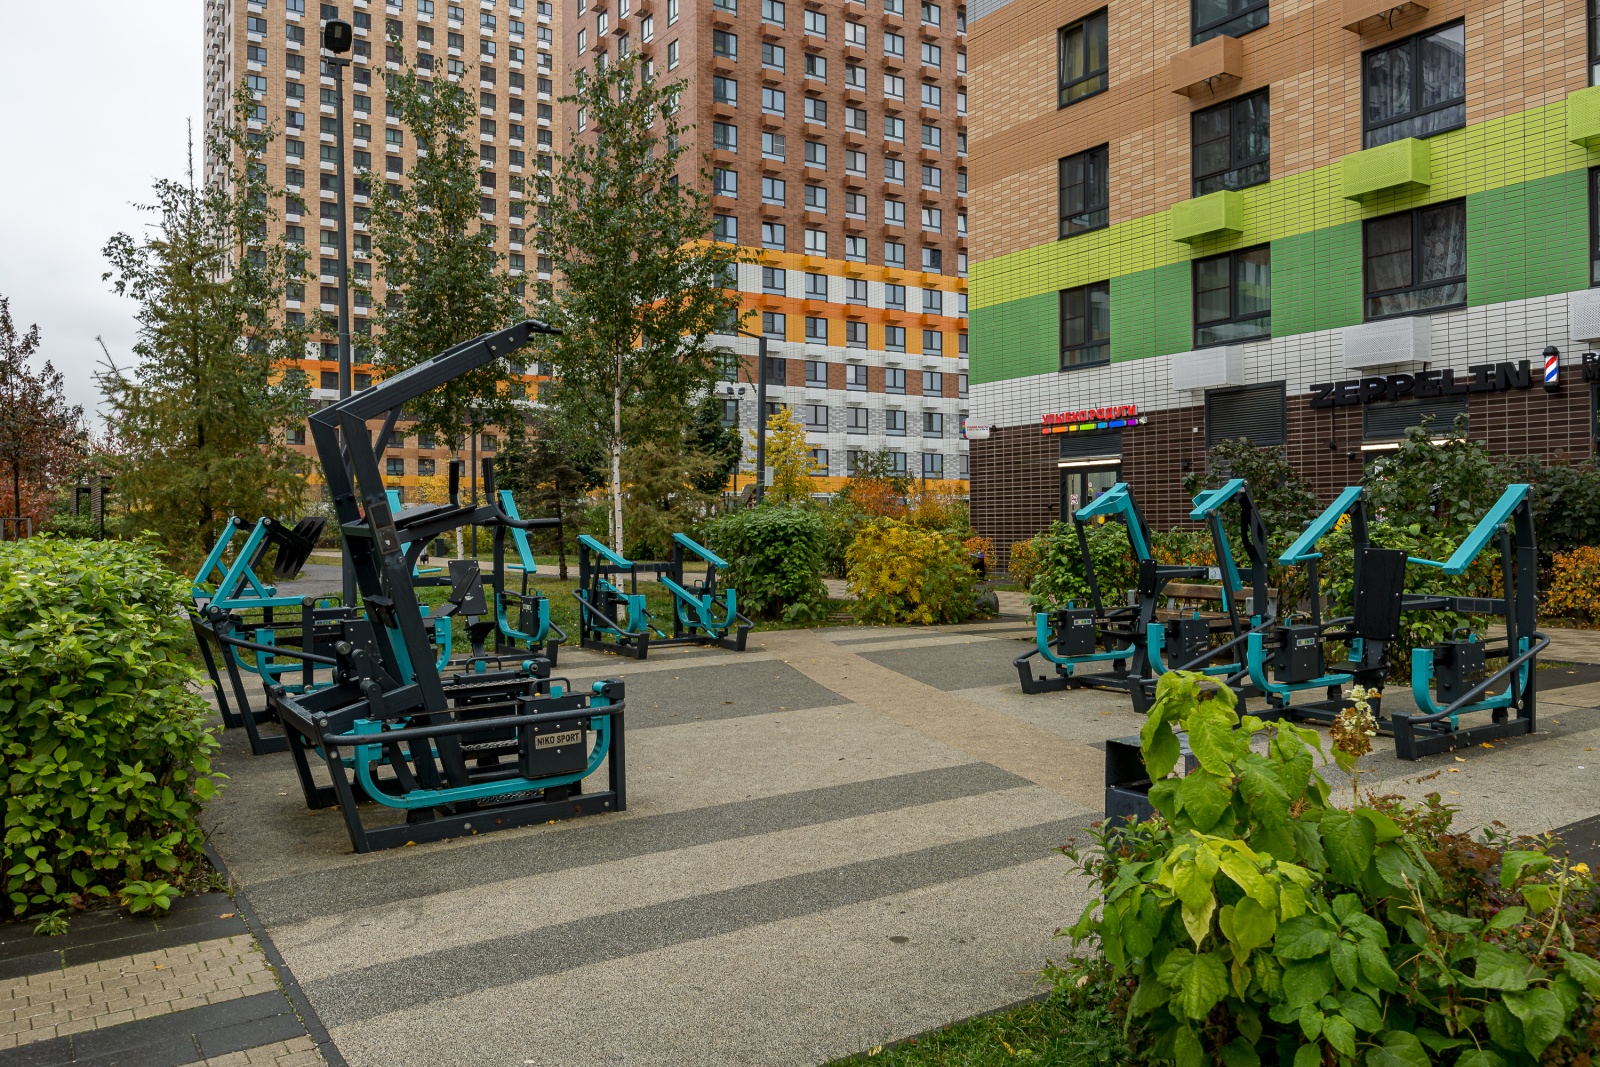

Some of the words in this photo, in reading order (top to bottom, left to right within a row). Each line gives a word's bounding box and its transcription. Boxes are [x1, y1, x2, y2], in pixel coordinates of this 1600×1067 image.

[1309, 359, 1532, 408] ZEPPELIN
[537, 736, 555, 746] NIKO
[557, 732, 579, 743] SPORT
